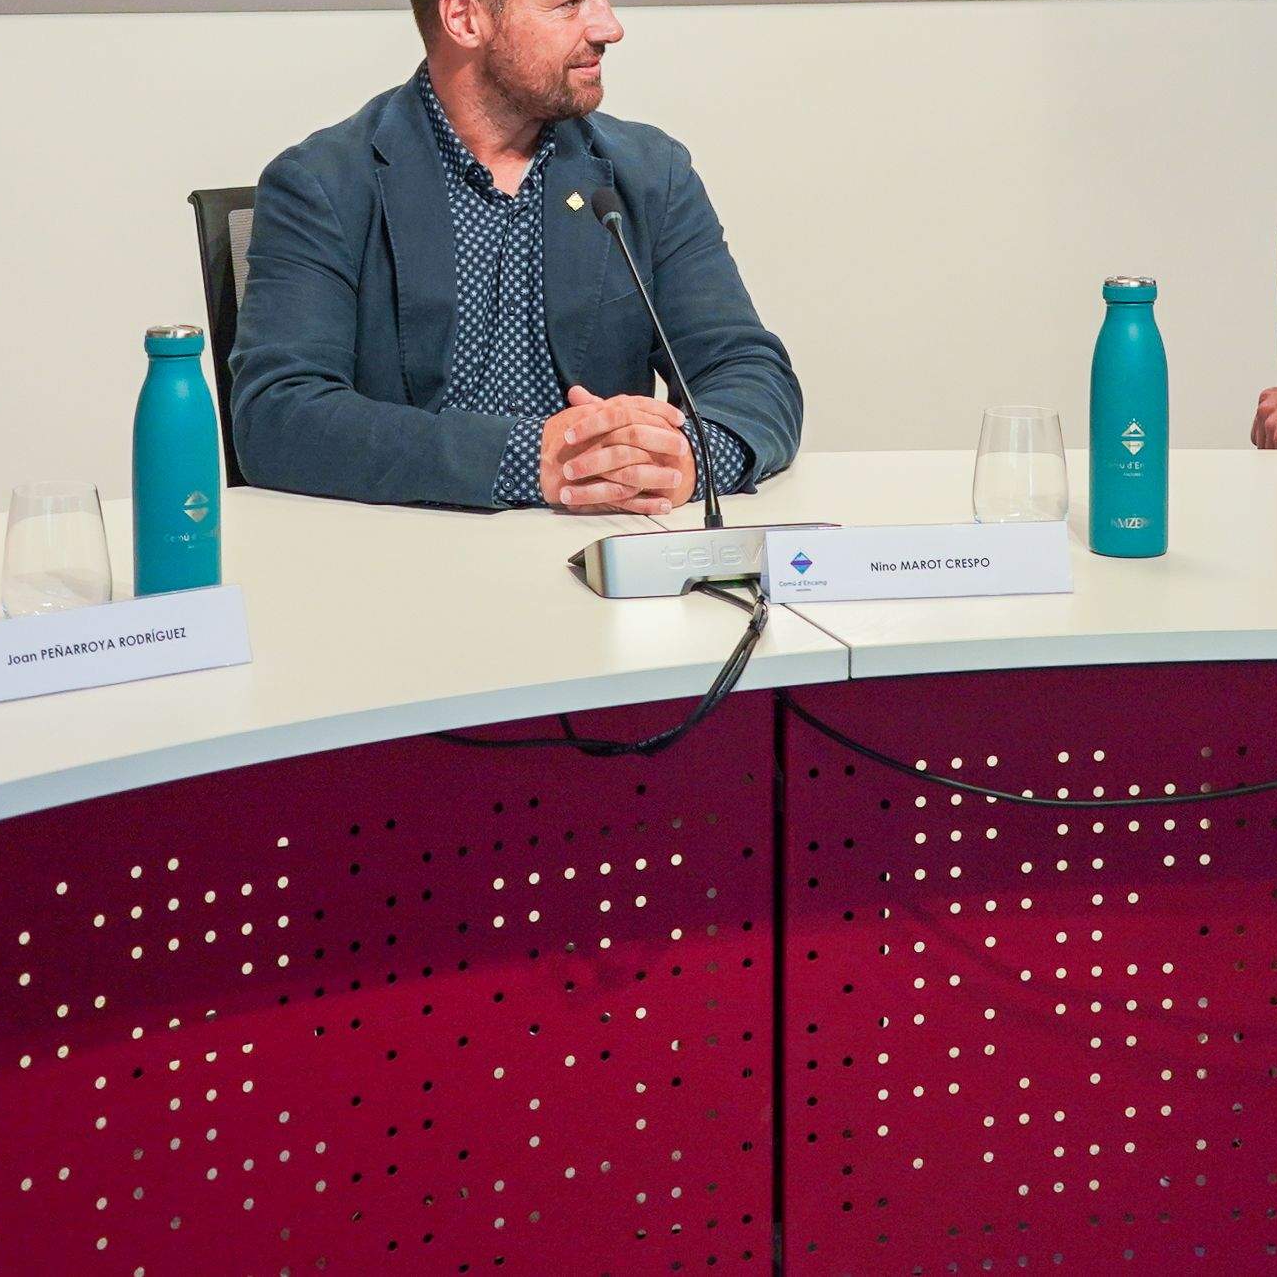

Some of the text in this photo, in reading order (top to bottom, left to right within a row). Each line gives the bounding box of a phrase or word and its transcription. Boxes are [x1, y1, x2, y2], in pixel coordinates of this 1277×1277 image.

[661, 539, 764, 570] telev
[869, 556, 991, 572] Nino MAROT CRESPO
[7, 627, 187, 666] Joan PEÑARROYA RODRÍGUEZ
